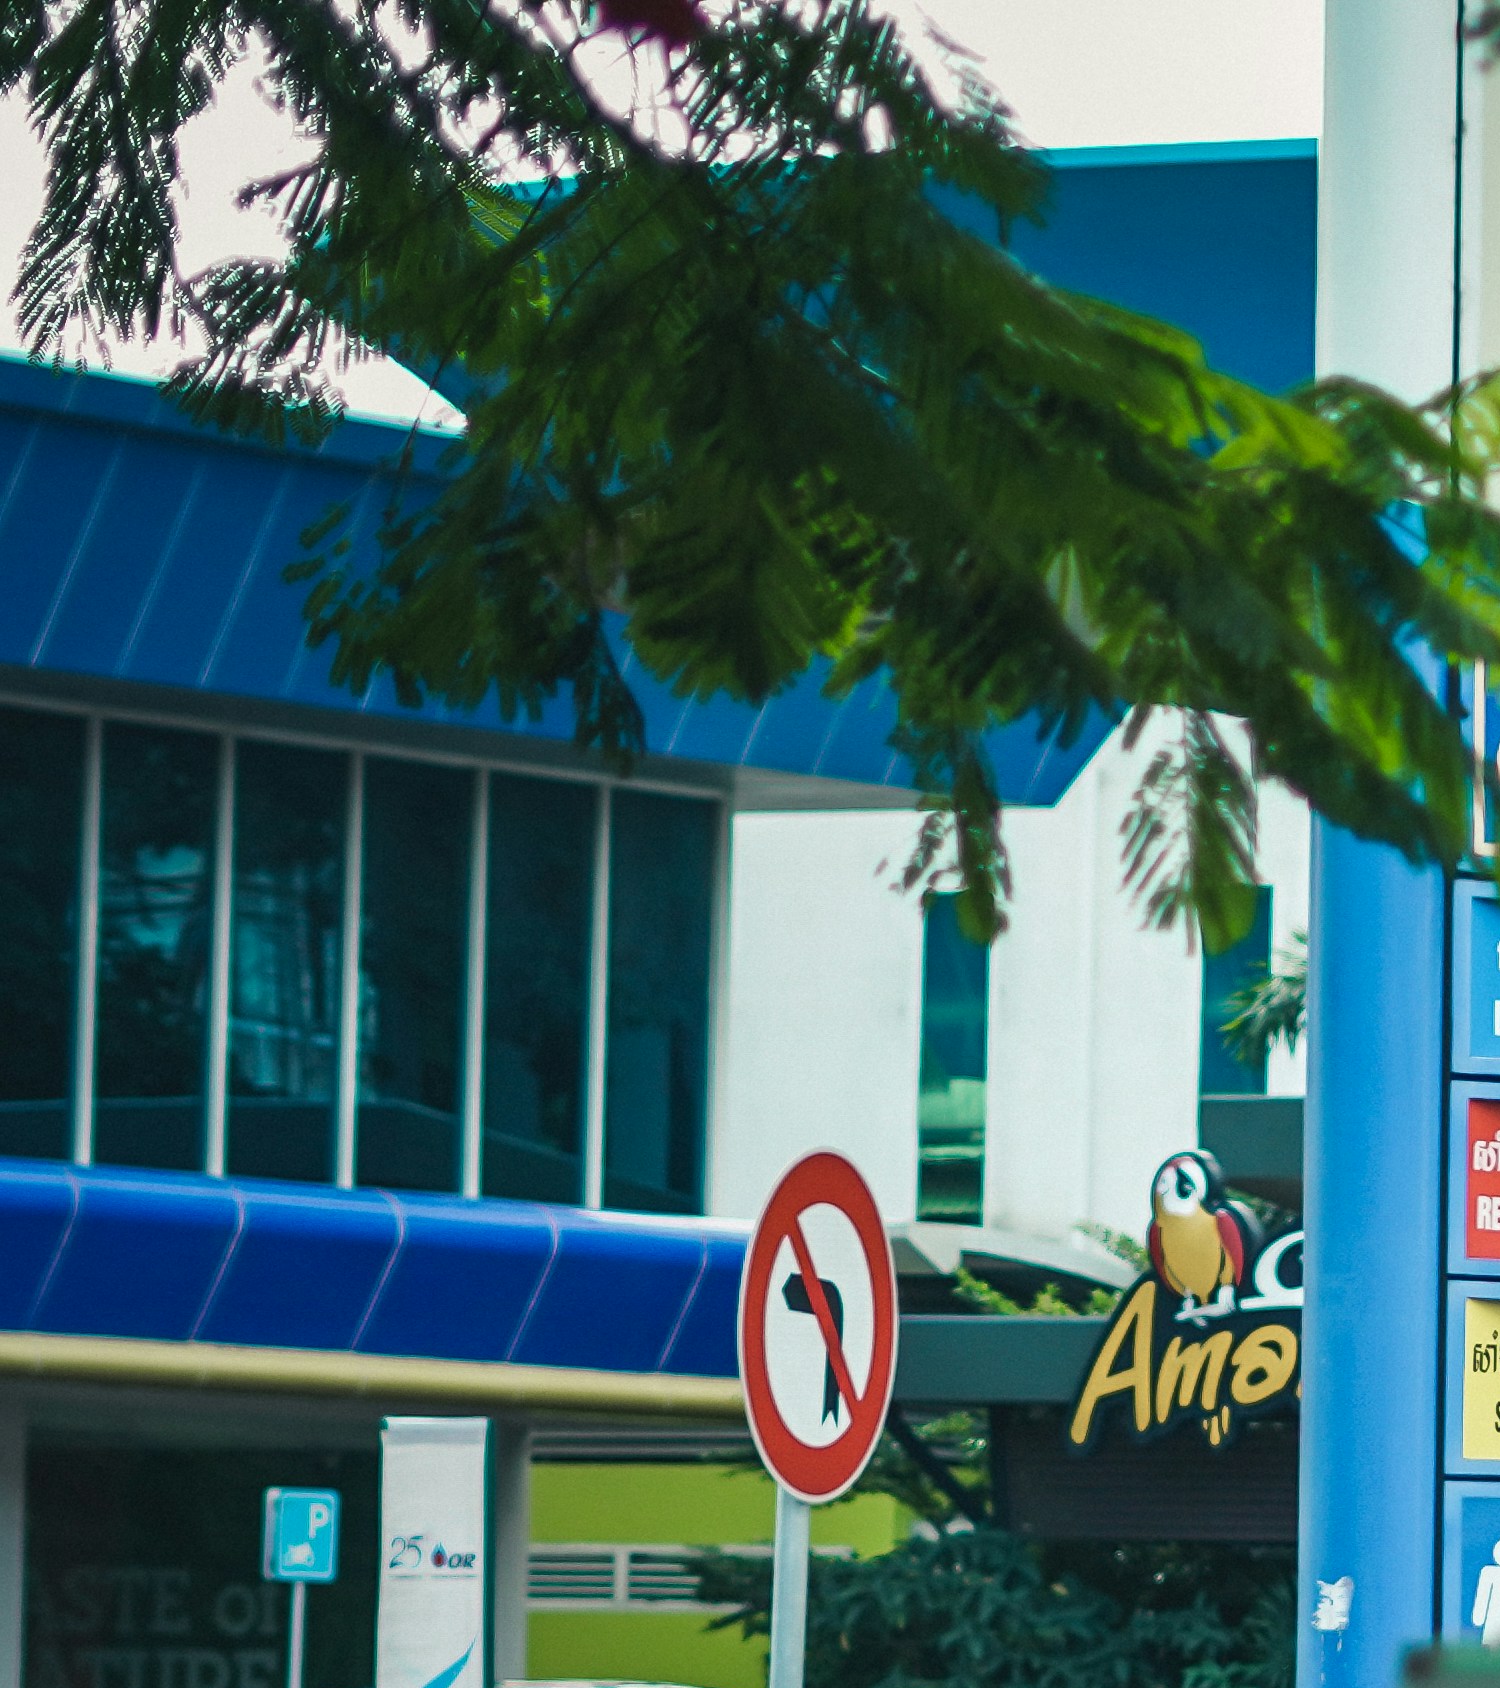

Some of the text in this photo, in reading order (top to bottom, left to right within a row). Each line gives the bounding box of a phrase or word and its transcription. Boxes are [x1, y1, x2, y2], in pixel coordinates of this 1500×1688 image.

[308, 1502, 330, 1539] P
[389, 1535, 476, 1569] 25 OR
